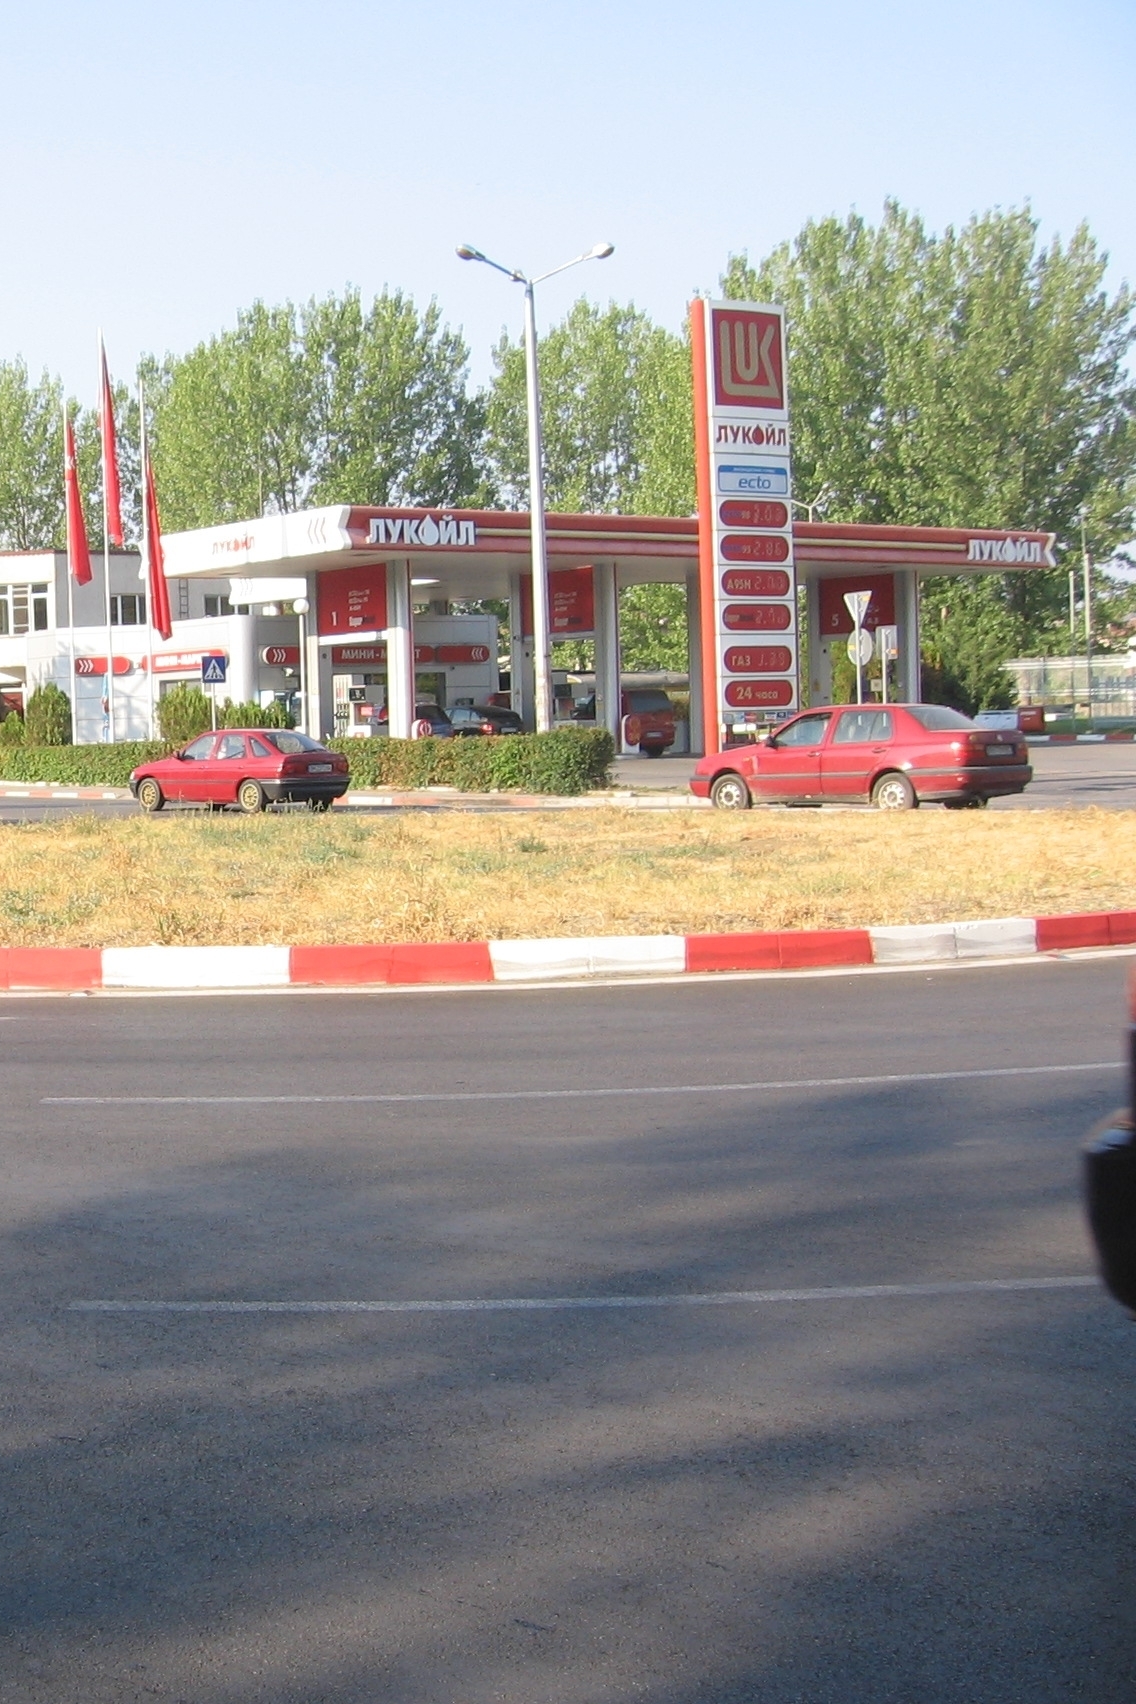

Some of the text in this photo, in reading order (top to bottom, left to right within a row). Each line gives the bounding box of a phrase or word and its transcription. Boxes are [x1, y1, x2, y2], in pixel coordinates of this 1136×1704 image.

[716, 423, 786, 447] ЛУКОЙЛ
[738, 475, 771, 489] ecto
[365, 513, 475, 546] ЛУКОЙЛ
[967, 536, 1041, 562] ЛУКОЙЛ
[831, 613, 839, 627] 5
[731, 655, 751, 667] ГАЗ
[736, 686, 753, 700] 24
